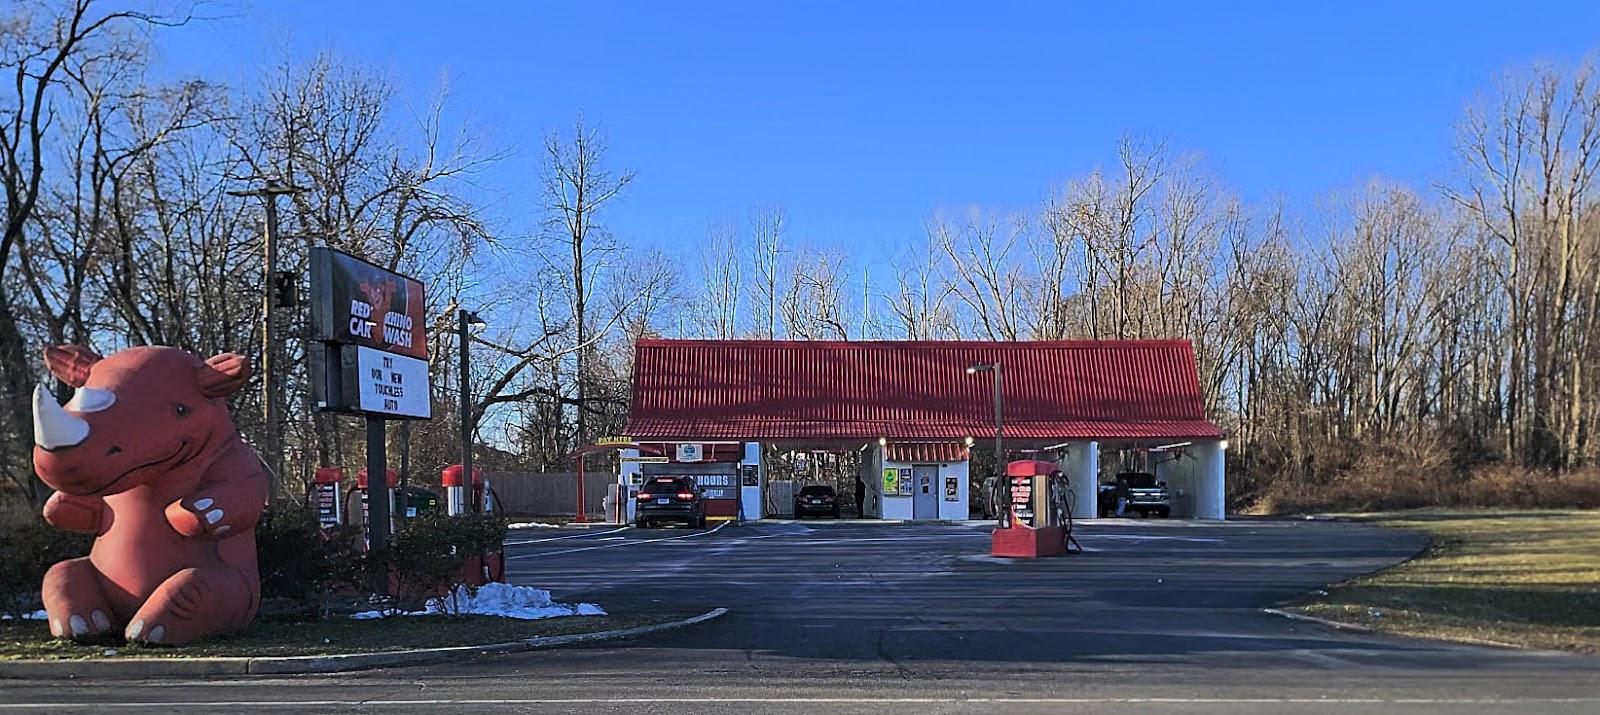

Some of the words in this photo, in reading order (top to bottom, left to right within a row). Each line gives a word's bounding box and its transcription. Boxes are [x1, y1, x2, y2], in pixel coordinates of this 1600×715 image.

[351, 300, 370, 318] RED
[350, 317, 372, 338] CAR
[383, 326, 412, 348] WASH
[391, 372, 402, 384] NEW
[697, 475, 729, 486] HOURS
